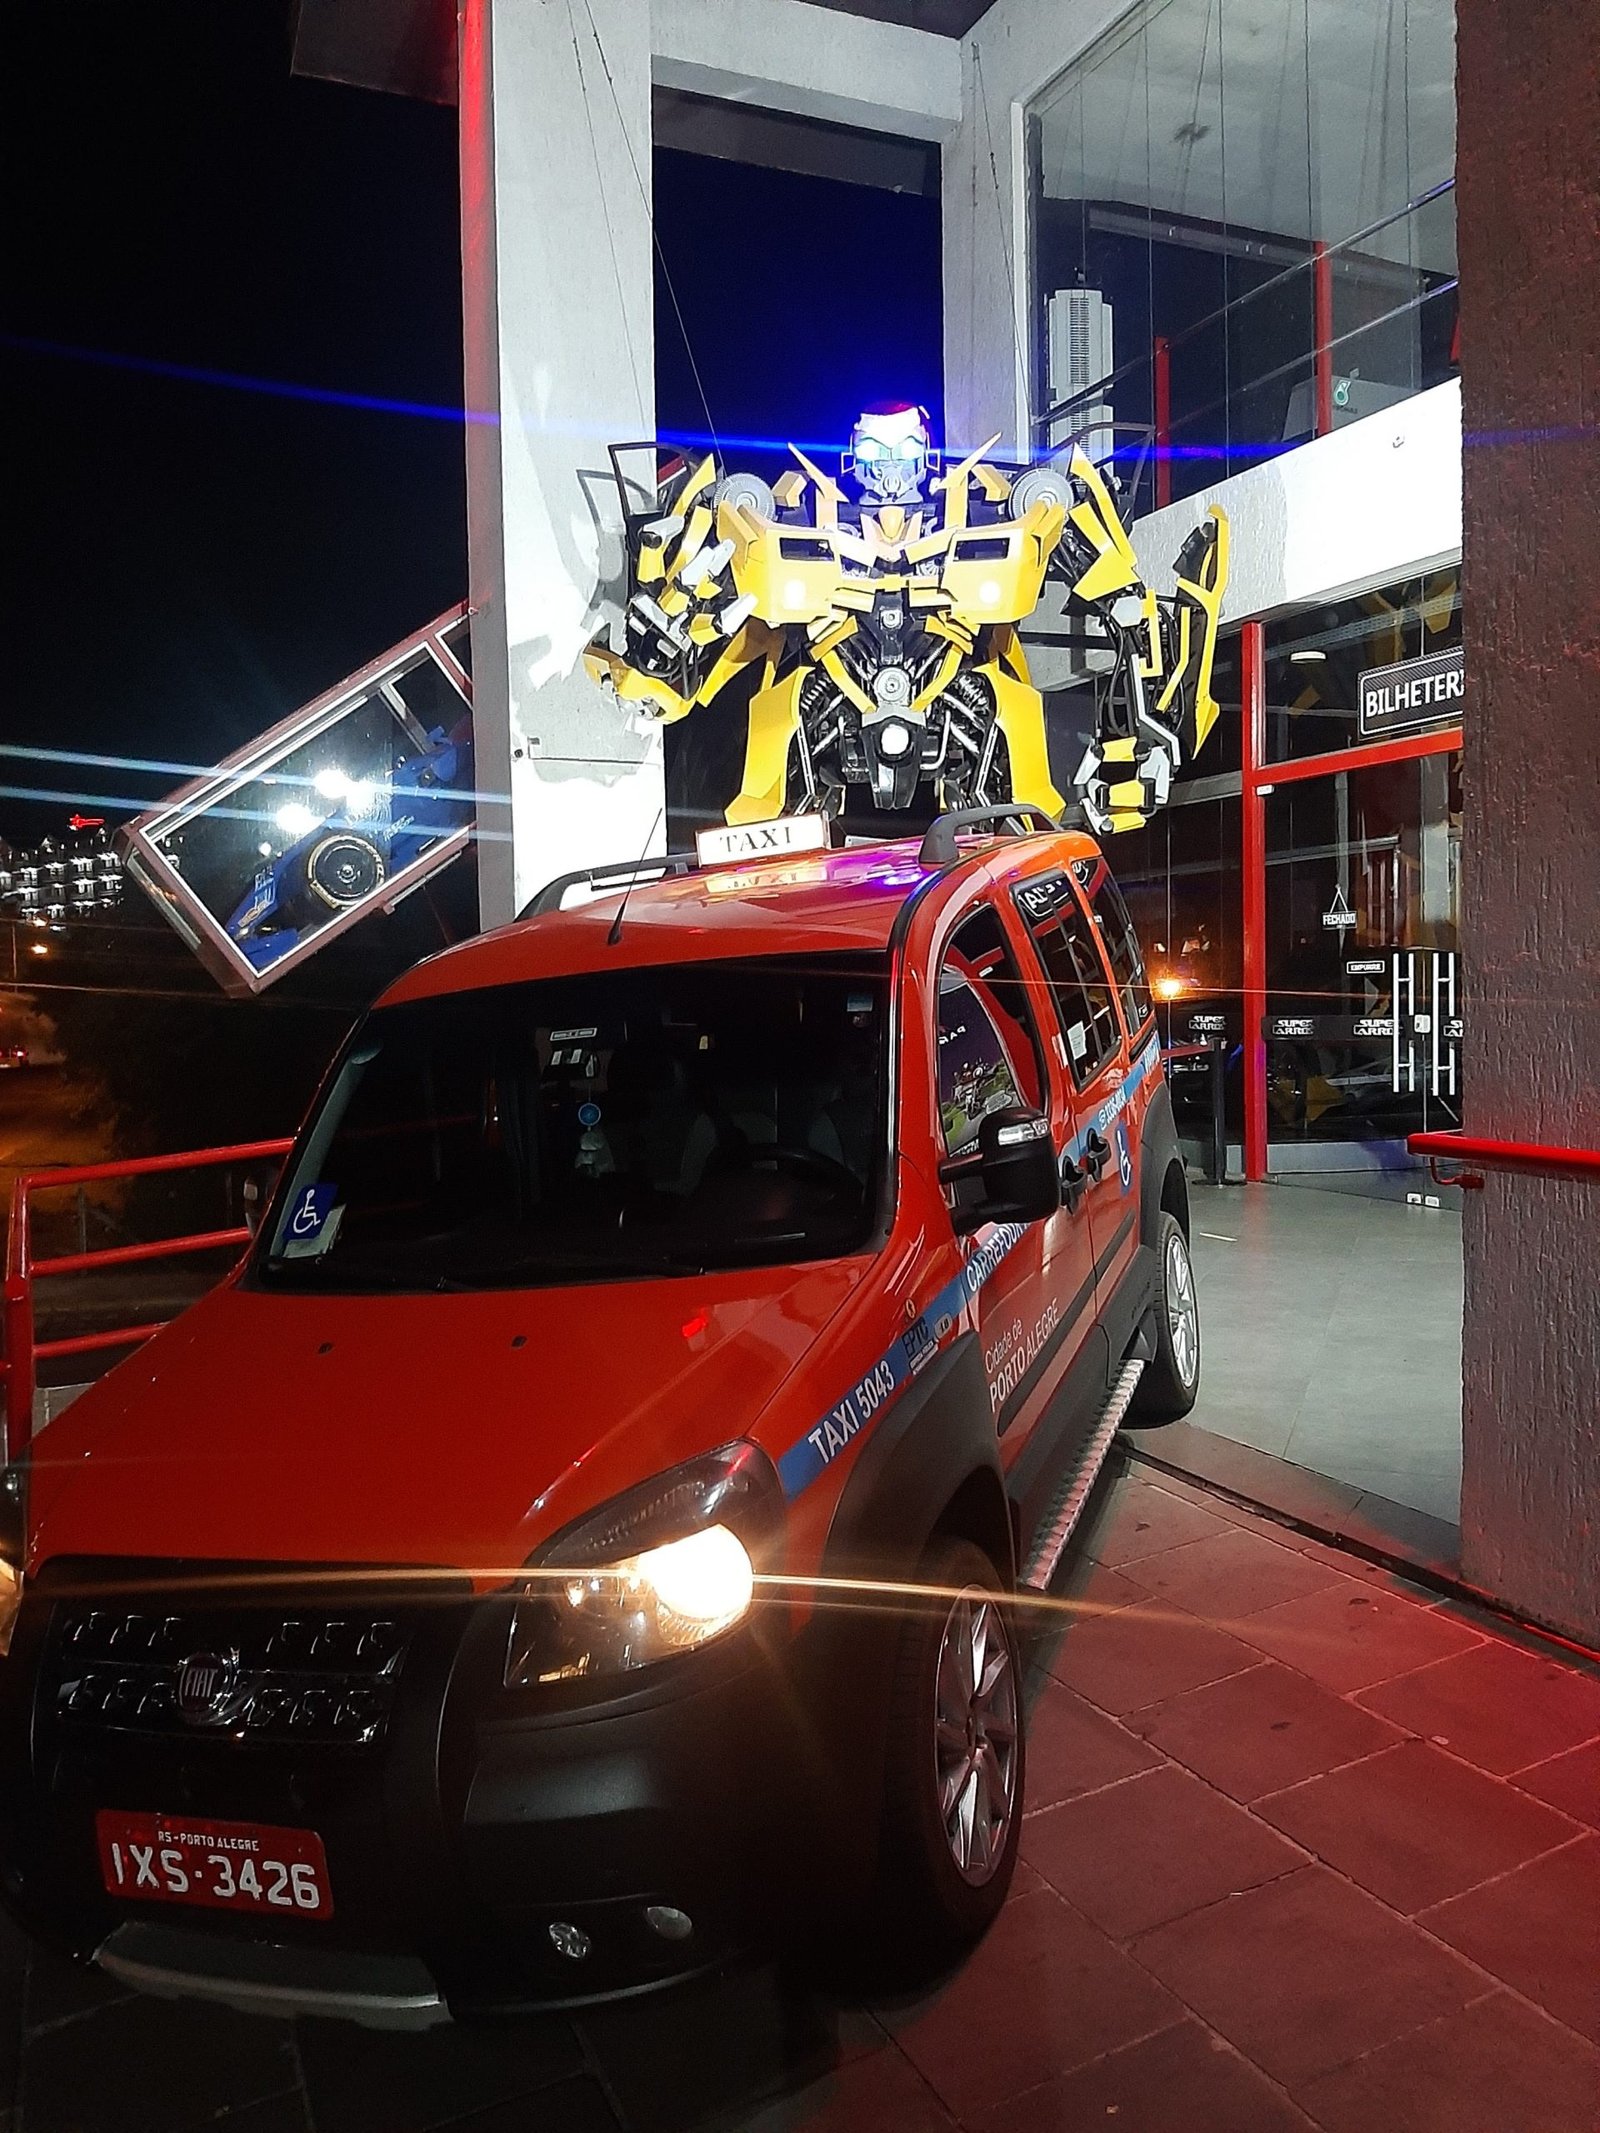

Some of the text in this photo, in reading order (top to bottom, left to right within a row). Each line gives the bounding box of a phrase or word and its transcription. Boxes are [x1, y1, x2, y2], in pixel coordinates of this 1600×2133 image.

[720, 826, 792, 852] TAXI
[1322, 912, 1356, 926] FECHADO
[1359, 1018, 1395, 1027] SUPE
[902, 1316, 929, 1356] EPTC
[985, 1317, 1022, 1374] Cidade de
[989, 1298, 1061, 1413] PORTO ALEGRE
[808, 1360, 895, 1464] TAXI 5043
[184, 1667, 219, 1698] FIAT
[217, 1838, 260, 1852] ALEGRE
